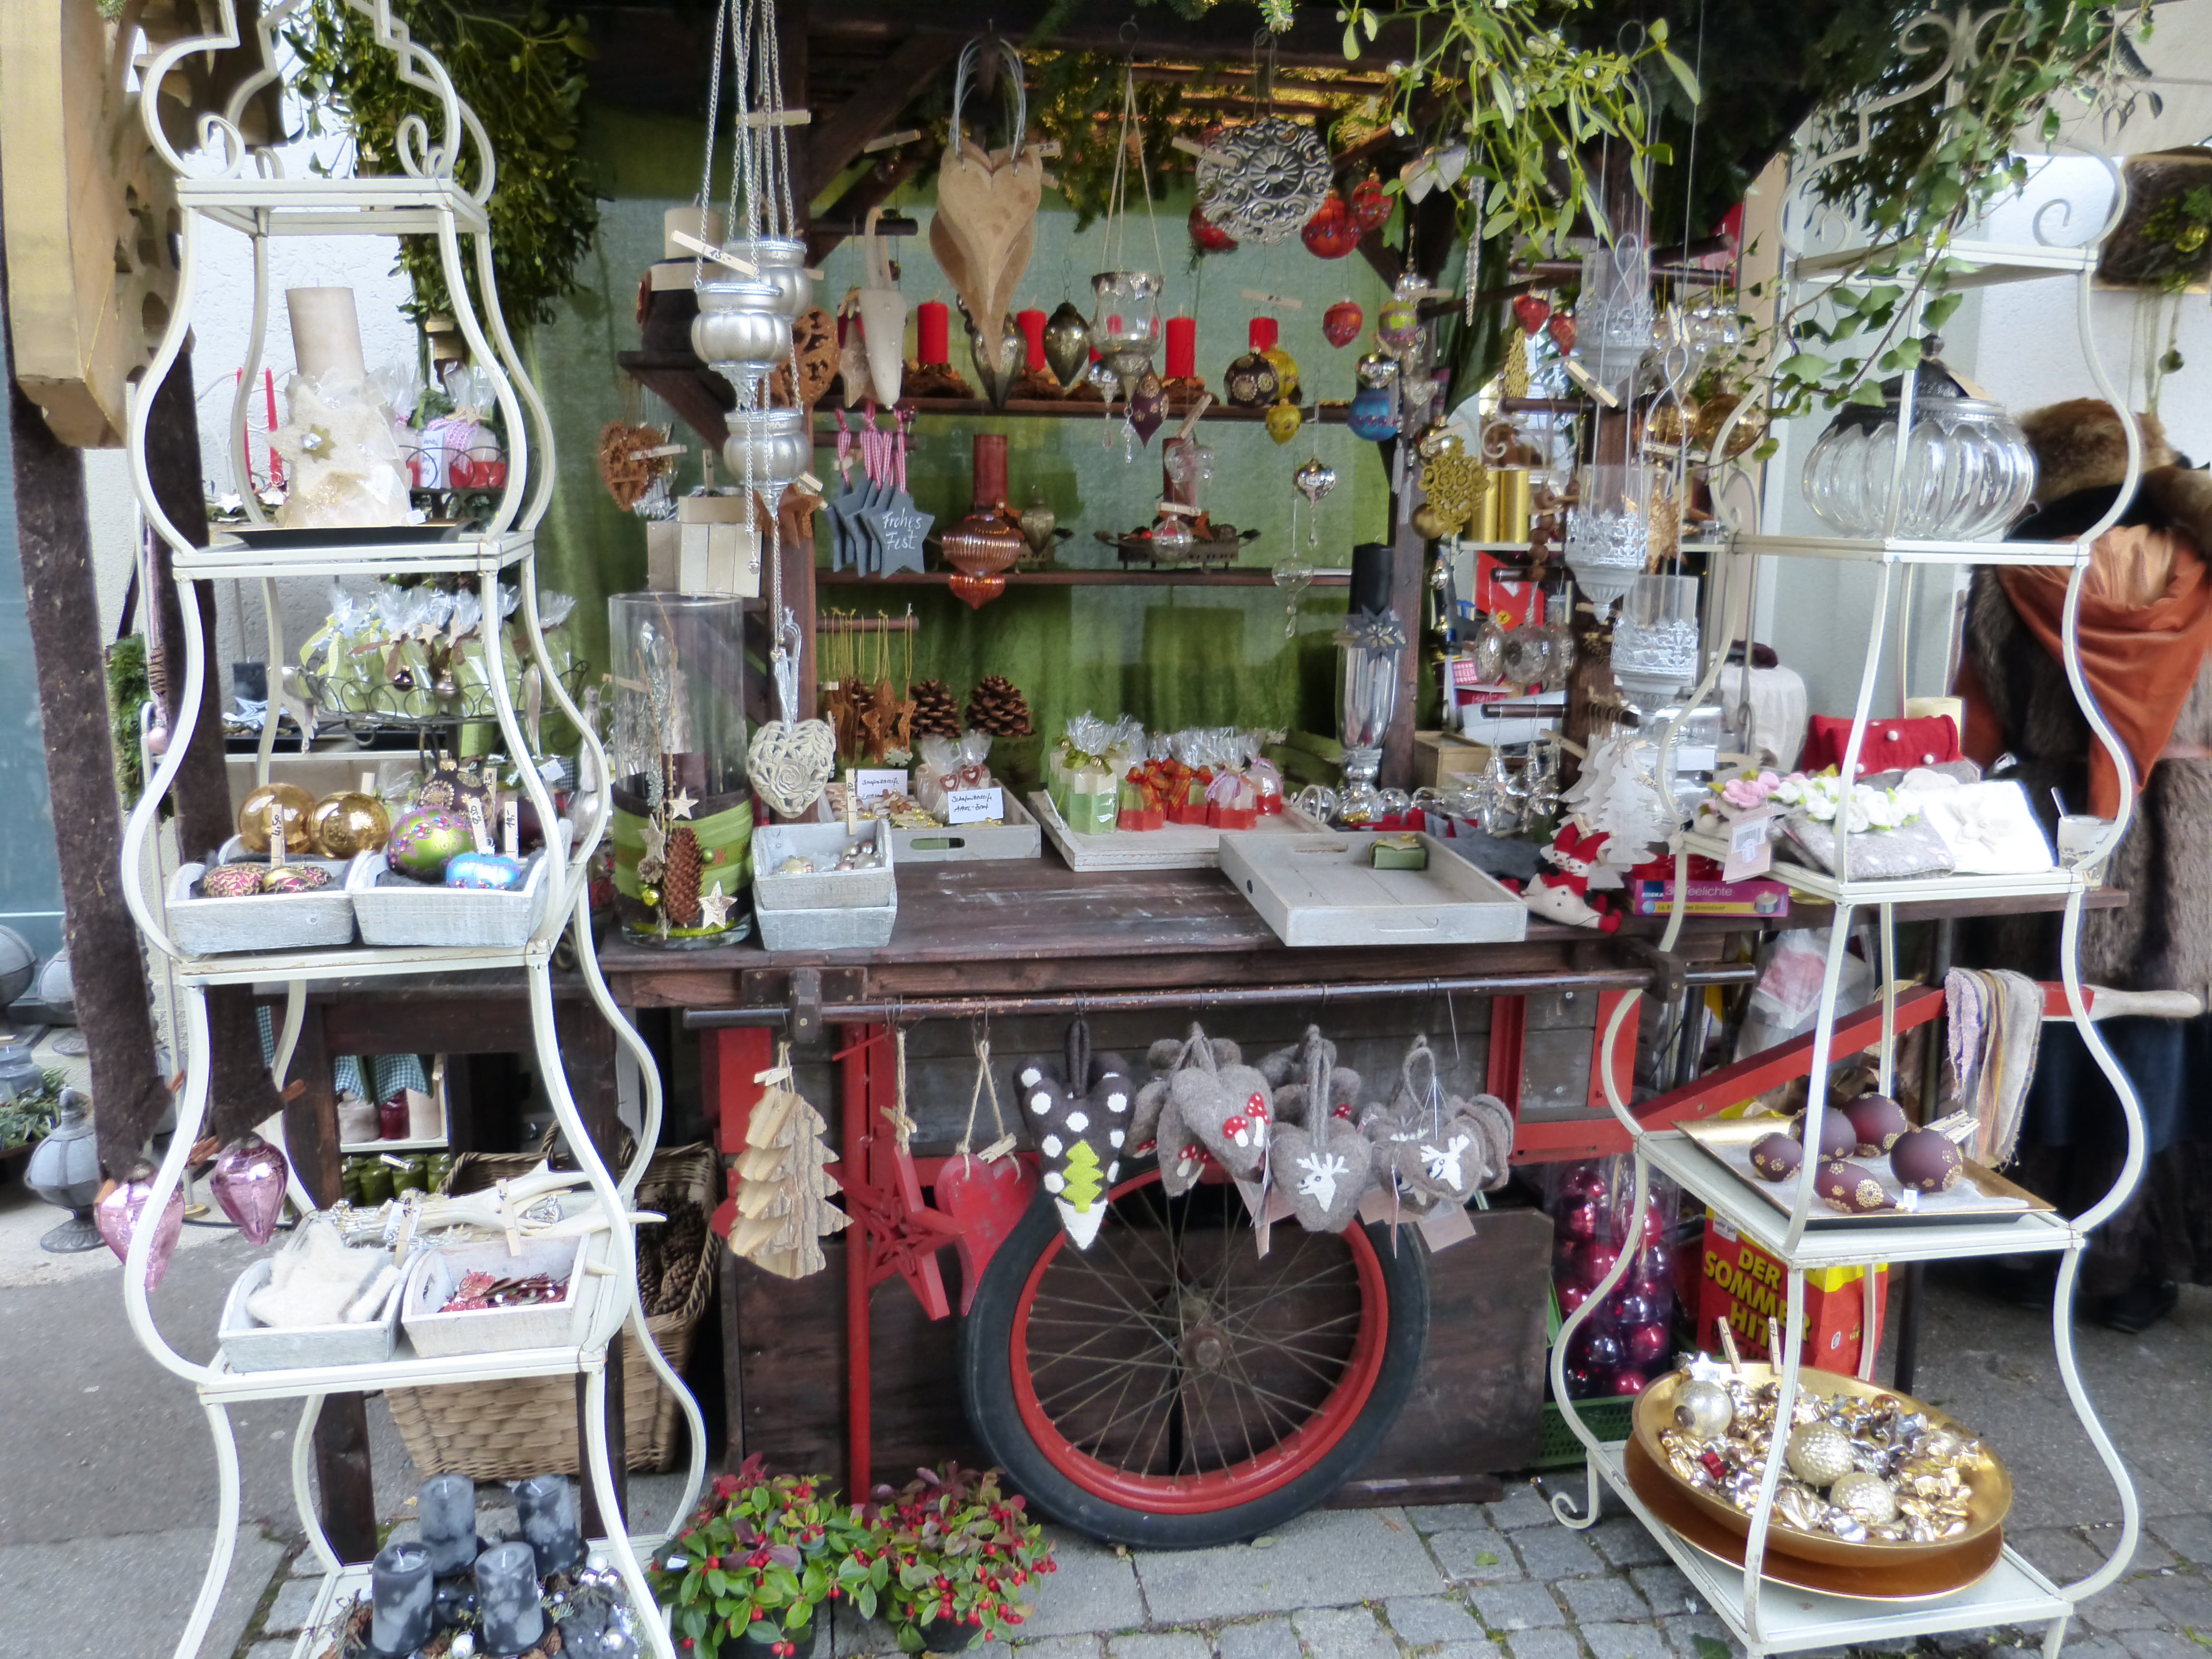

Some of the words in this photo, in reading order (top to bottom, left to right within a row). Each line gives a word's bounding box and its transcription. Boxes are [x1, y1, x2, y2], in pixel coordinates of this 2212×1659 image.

[882, 507, 922, 529] Frohes
[886, 529, 917, 550] Fest
[1738, 1246, 1780, 1290] DER
[1704, 1250, 1811, 1341] SOMMER
[1730, 1301, 1770, 1347] HIT
